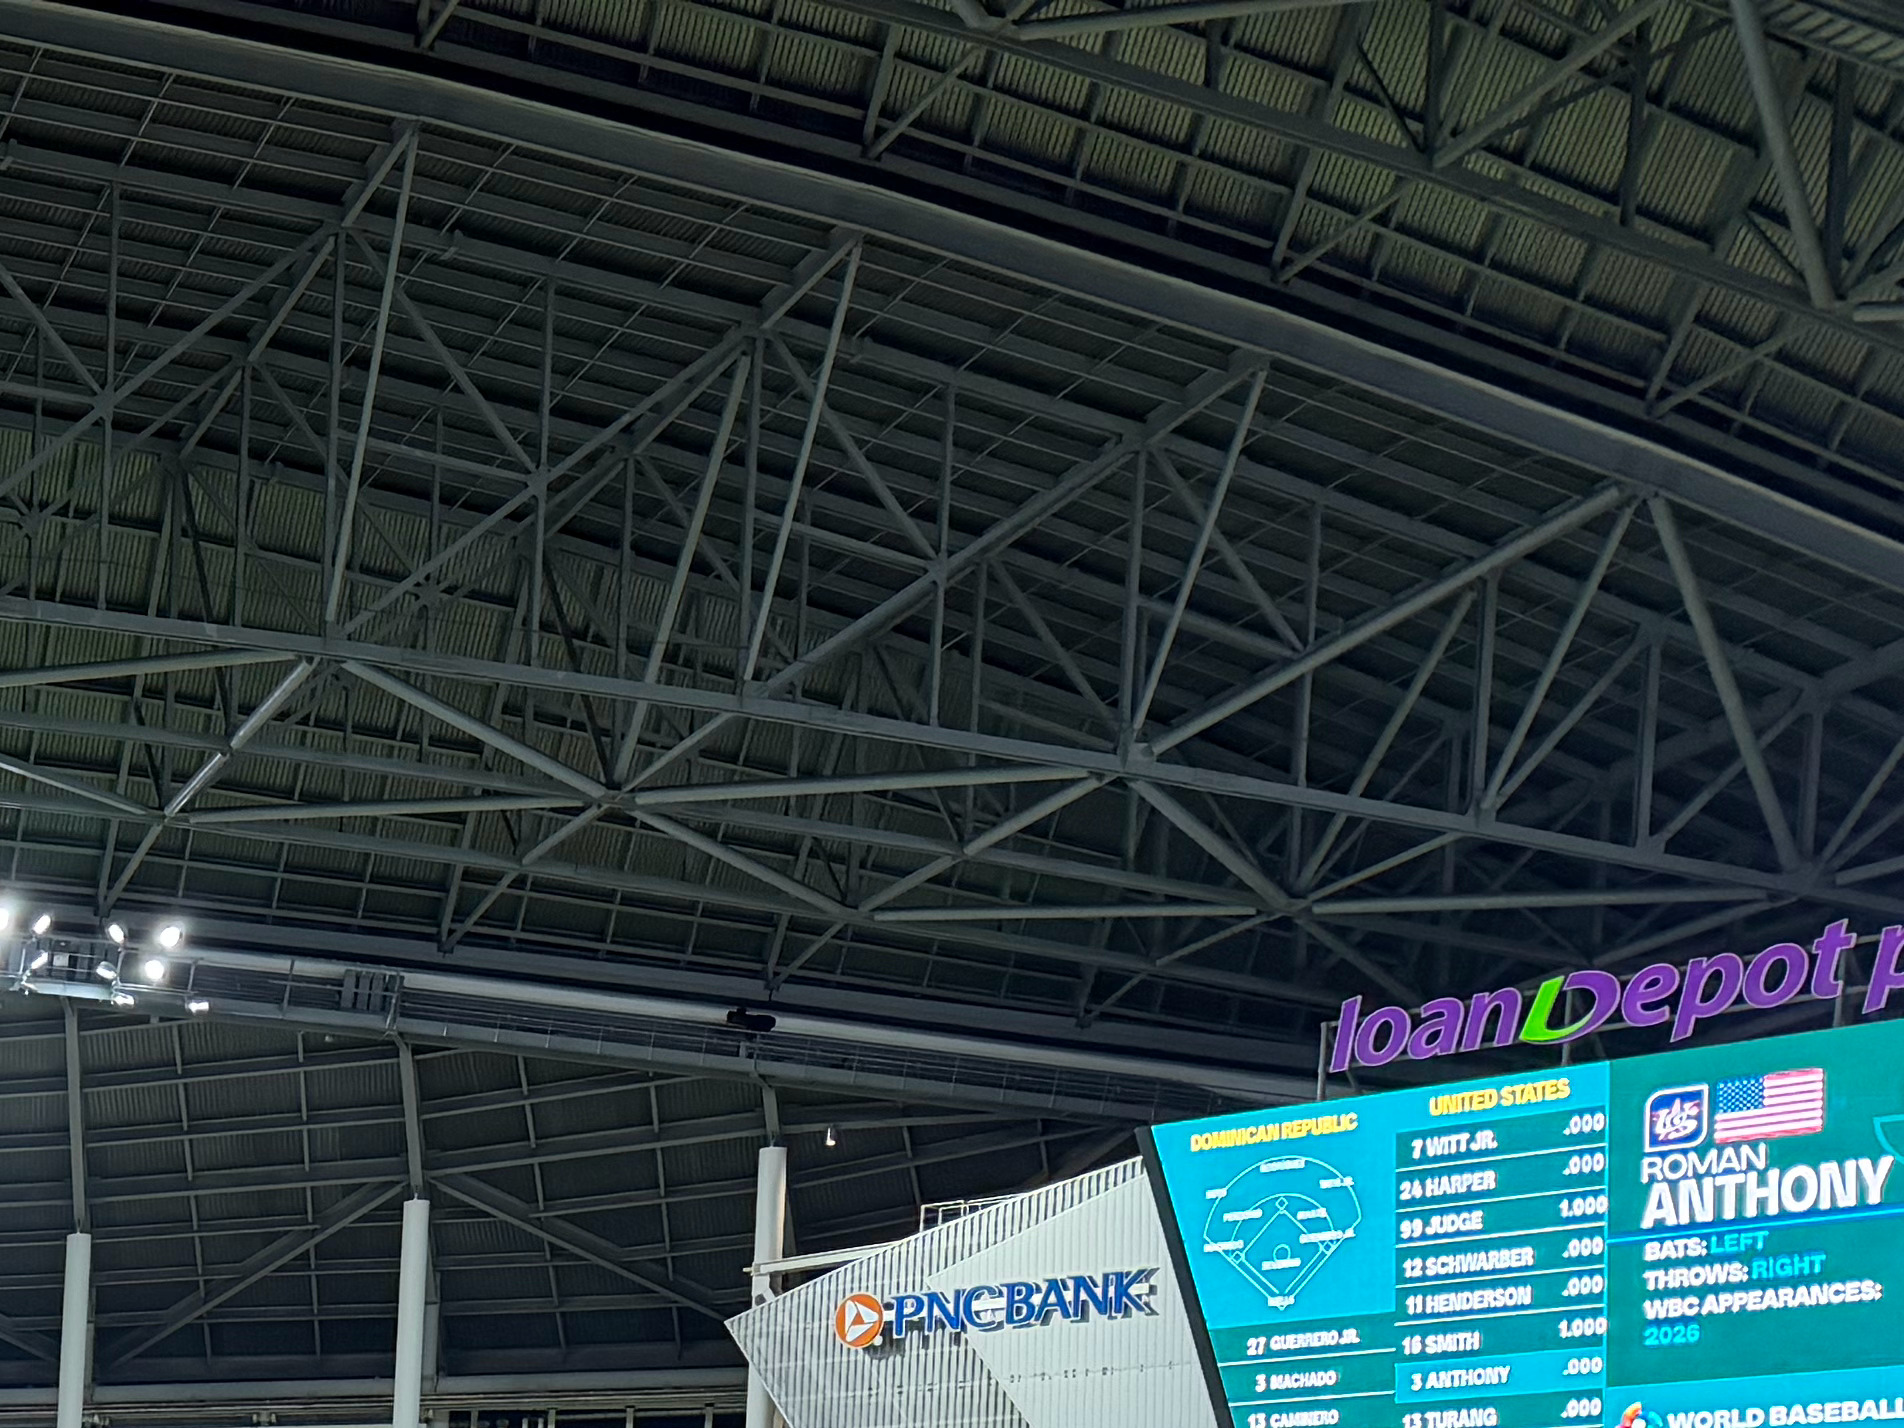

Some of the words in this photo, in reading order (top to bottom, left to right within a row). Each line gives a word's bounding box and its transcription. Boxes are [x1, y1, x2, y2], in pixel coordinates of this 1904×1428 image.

[1330, 918, 1856, 1073] loanDepot
[1429, 1088, 1498, 1116] UNITED
[1500, 1078, 1570, 1106] STATES
[1191, 1122, 1281, 1152] DOMINICAN
[1281, 1112, 1358, 1139] REPUBLIC
[1425, 1133, 1470, 1156] WITT
[1640, 1142, 1768, 1184] ROMAN
[1425, 1170, 1496, 1197] HARPER
[1640, 1155, 1894, 1229] ANTHONY
[1400, 1218, 1423, 1239] 99
[1425, 1210, 1483, 1235] JUDGE
[1644, 1237, 1707, 1262] BATS:
[1710, 1230, 1769, 1254] LEFT
[1403, 1258, 1423, 1278] 12
[1425, 1247, 1534, 1276] SCHWARBER
[1643, 1262, 1748, 1290] THROWS:
[1752, 1252, 1826, 1278] RIGHT
[892, 1285, 1006, 1338] PNC
[1005, 1268, 1153, 1326] BANK
[1425, 1284, 1532, 1314] HENDERSON
[1644, 1299, 1700, 1320] WBC
[1701, 1279, 1883, 1316] APPEARANCES:
[1270, 1330, 1338, 1351] GUERRERO
[1425, 1331, 1480, 1354] SMITH
[1644, 1324, 1700, 1346] 2026
[1270, 1370, 1337, 1390] MACHADO
[1426, 1365, 1510, 1390] ANTHONY
